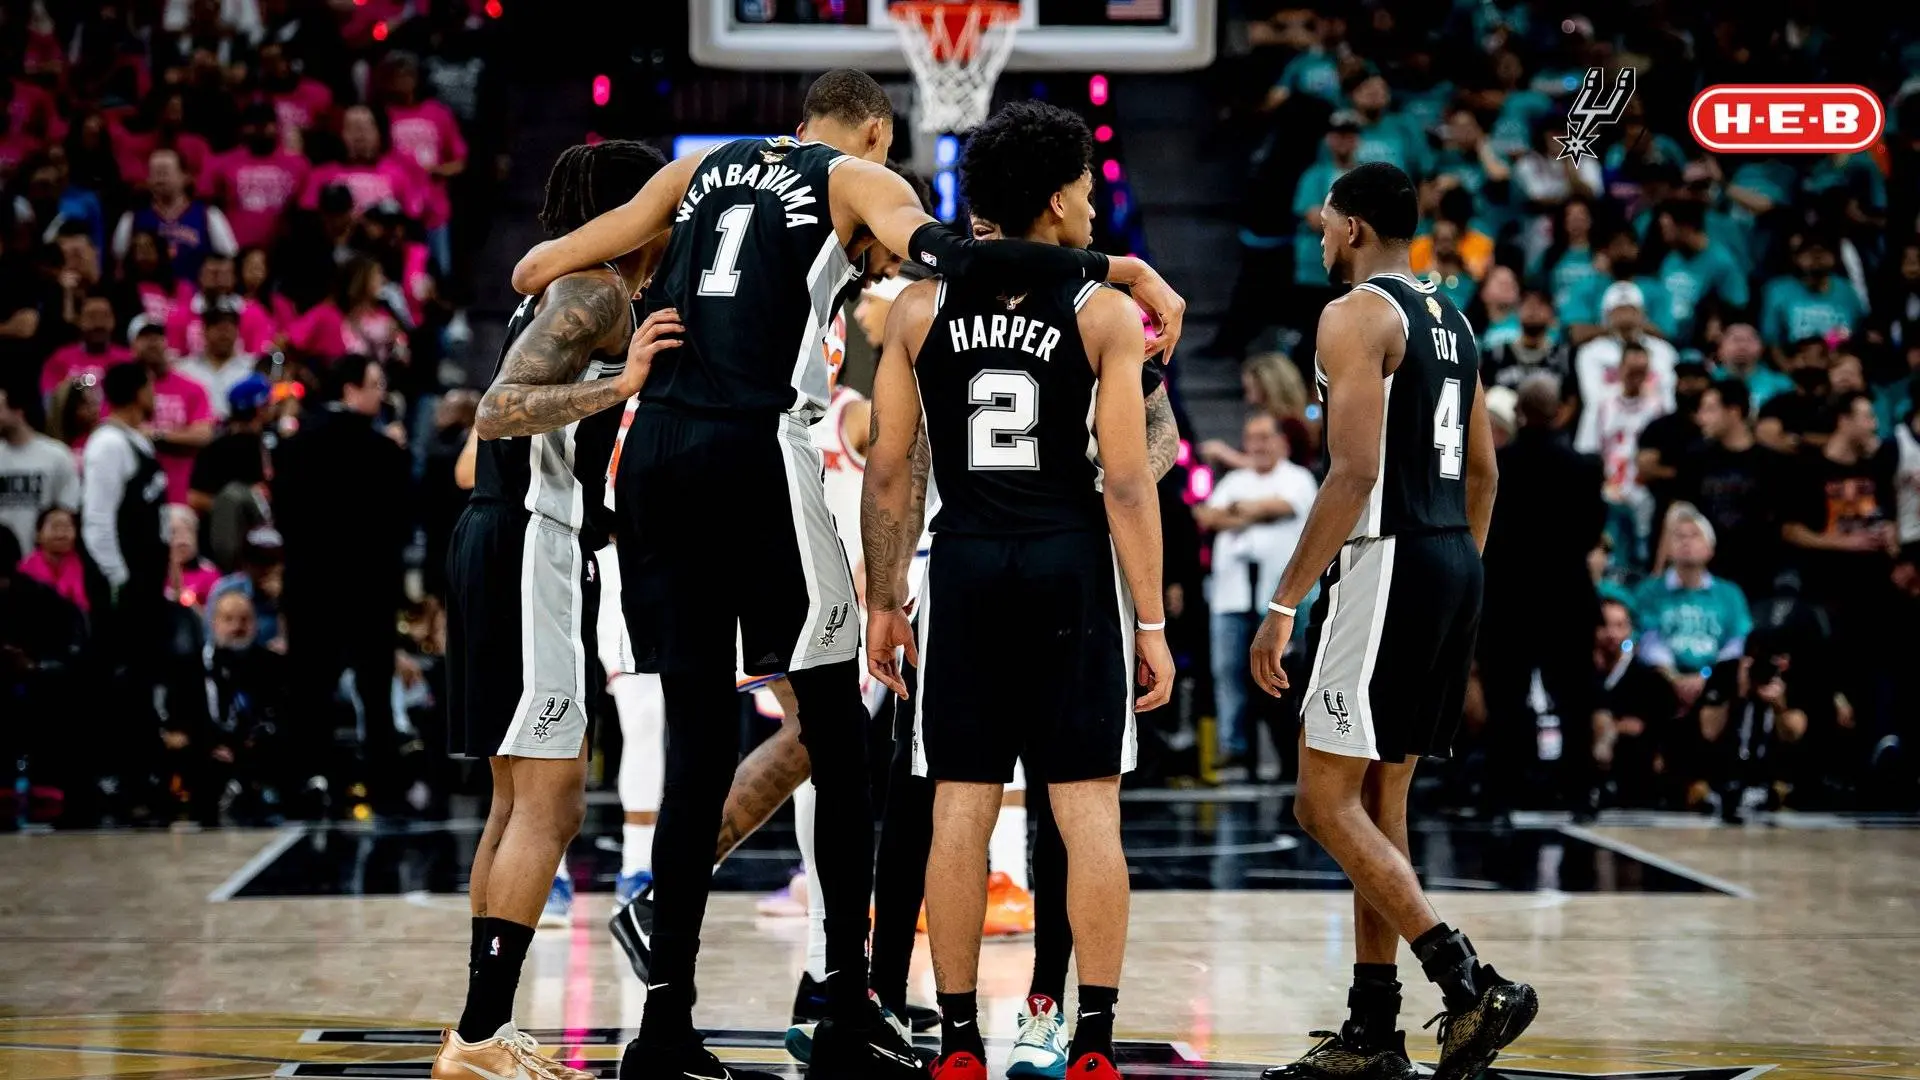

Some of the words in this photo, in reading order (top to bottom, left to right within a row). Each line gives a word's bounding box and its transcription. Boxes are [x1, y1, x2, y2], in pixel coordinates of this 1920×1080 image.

[675, 163, 819, 228] WEMBANYAMA
[696, 203, 756, 298] 1
[948, 313, 1062, 362] HARPER
[1430, 327, 1459, 365] FOX
[967, 368, 1041, 472] 2
[1433, 377, 1463, 481] 4
